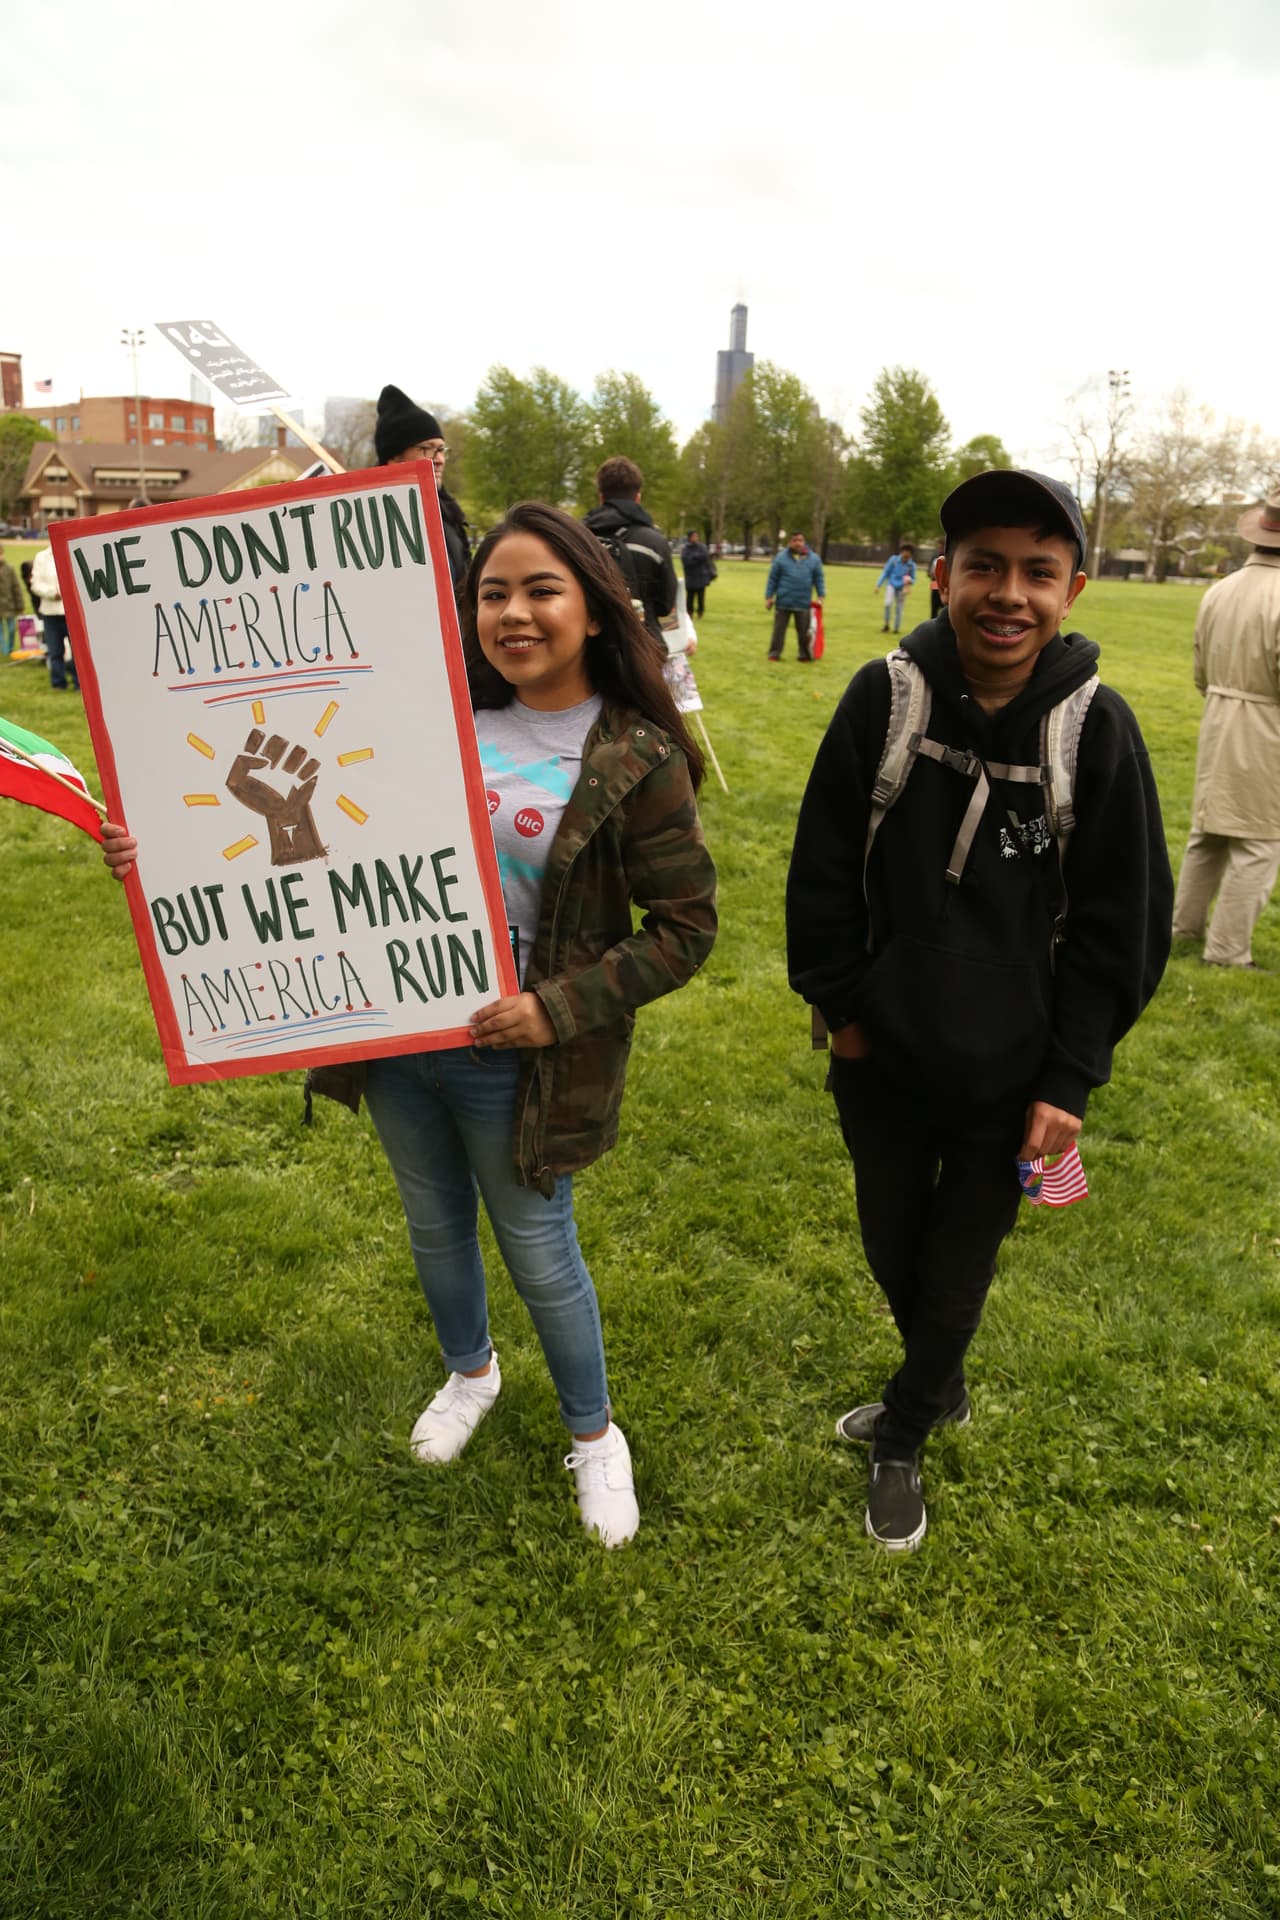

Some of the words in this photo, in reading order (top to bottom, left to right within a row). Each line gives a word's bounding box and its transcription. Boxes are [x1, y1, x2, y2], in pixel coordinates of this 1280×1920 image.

[73, 535, 151, 602] WE
[171, 504, 317, 588] DON'T
[330, 487, 426, 570] RUN
[152, 581, 359, 677] AMERICA
[517, 813, 542, 832] UIC
[151, 883, 229, 956] BUT
[241, 872, 315, 944] WE
[328, 847, 468, 934] MAKE
[181, 950, 372, 1036] AMERICA
[385, 929, 490, 1004] RUN
